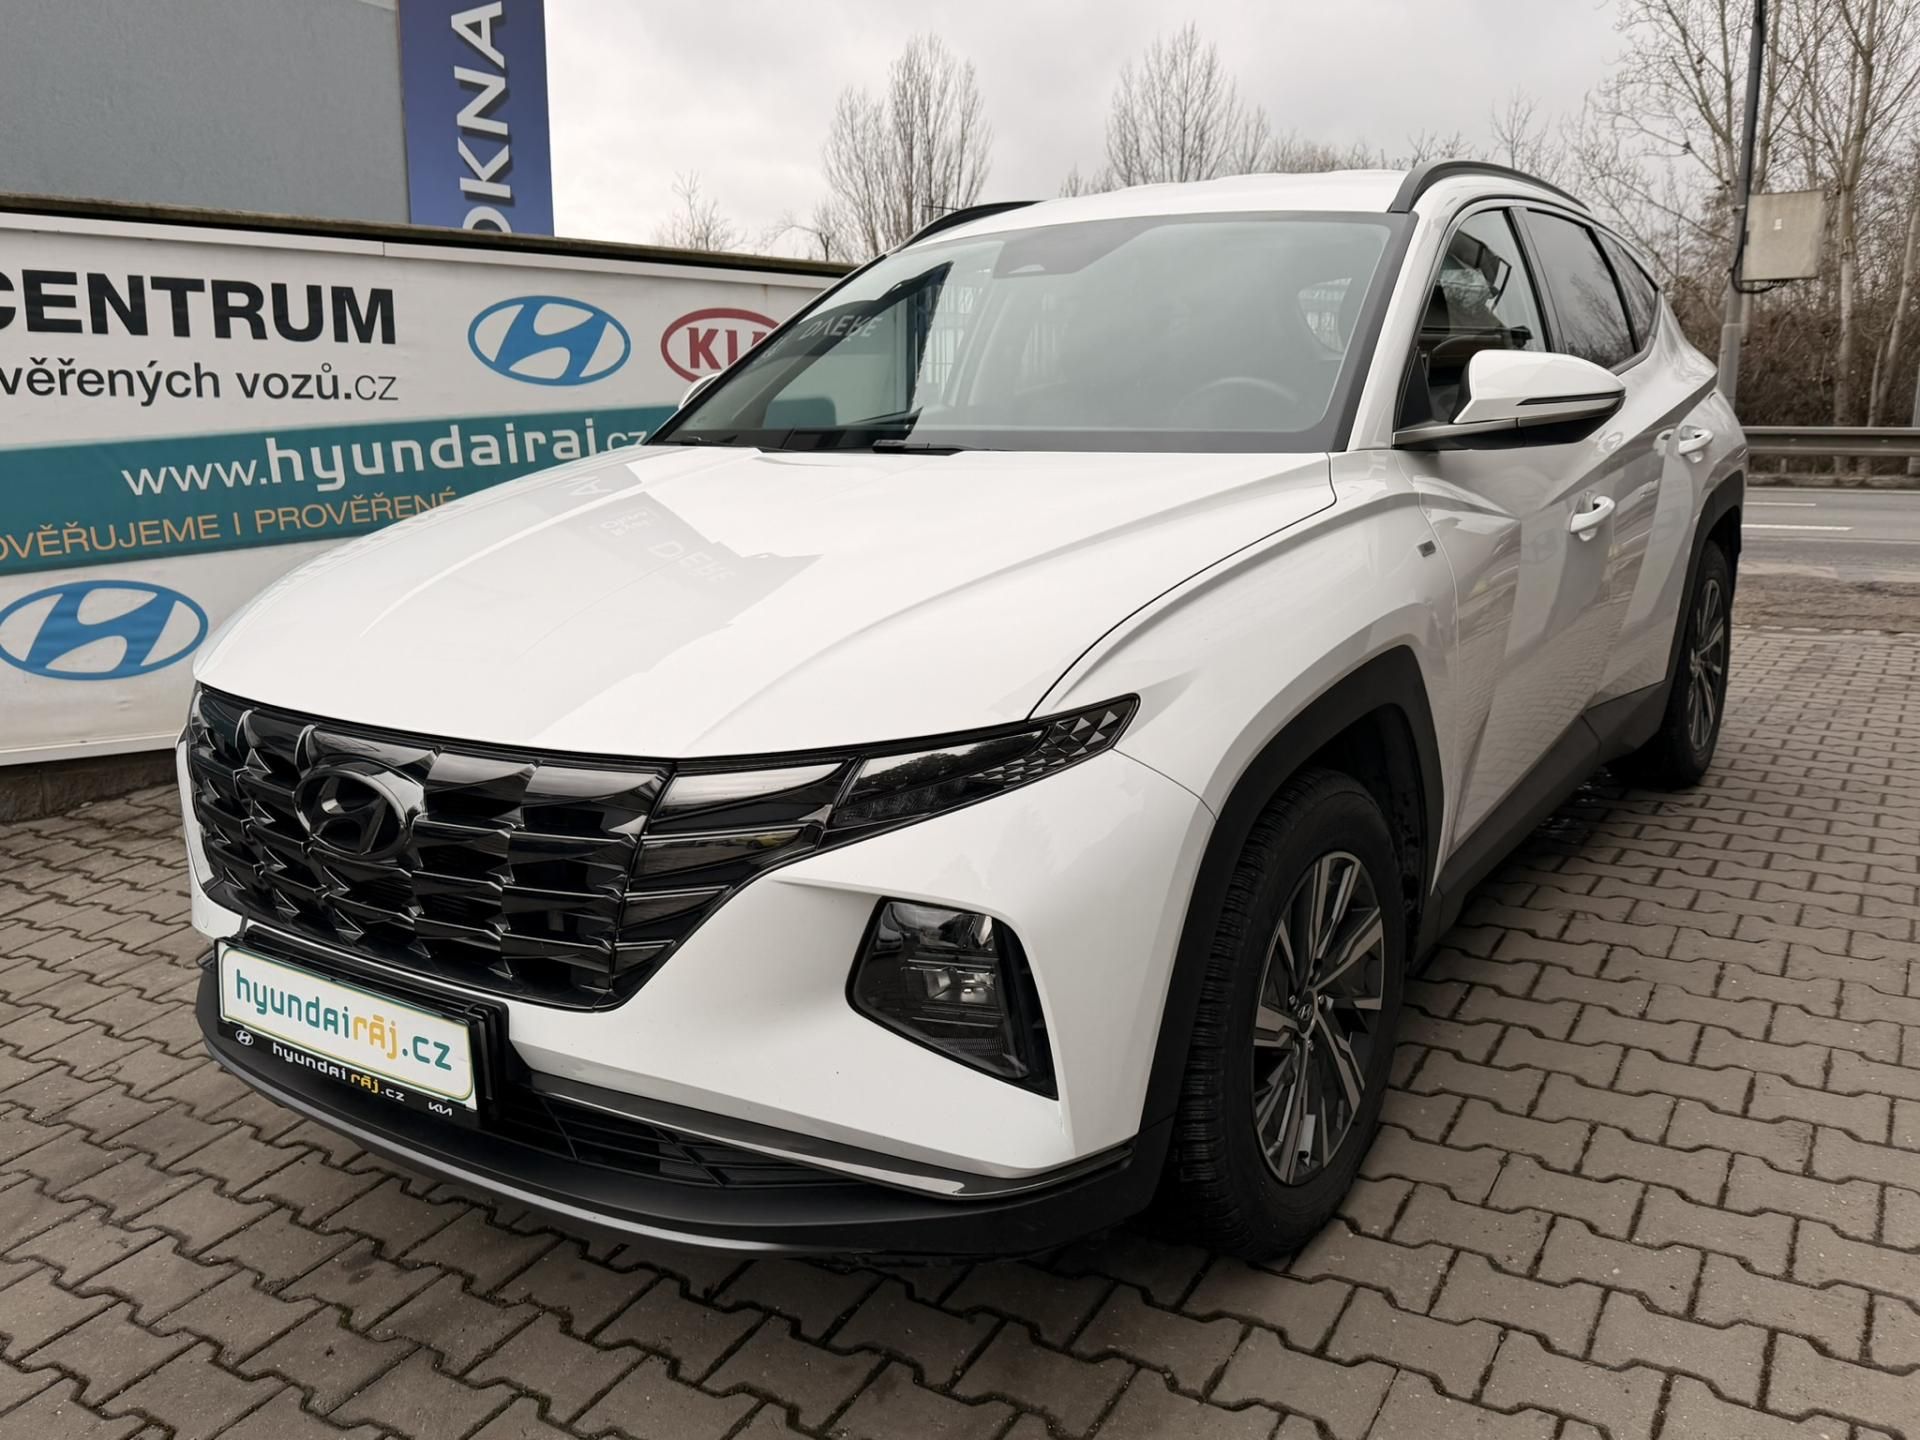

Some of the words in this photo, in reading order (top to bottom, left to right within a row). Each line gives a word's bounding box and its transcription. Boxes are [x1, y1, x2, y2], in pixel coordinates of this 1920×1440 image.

[0, 269, 396, 345] ENTRUM
[686, 327, 767, 370] KI
[236, 362, 399, 400] vozů.cz
[233, 512, 241, 536] I
